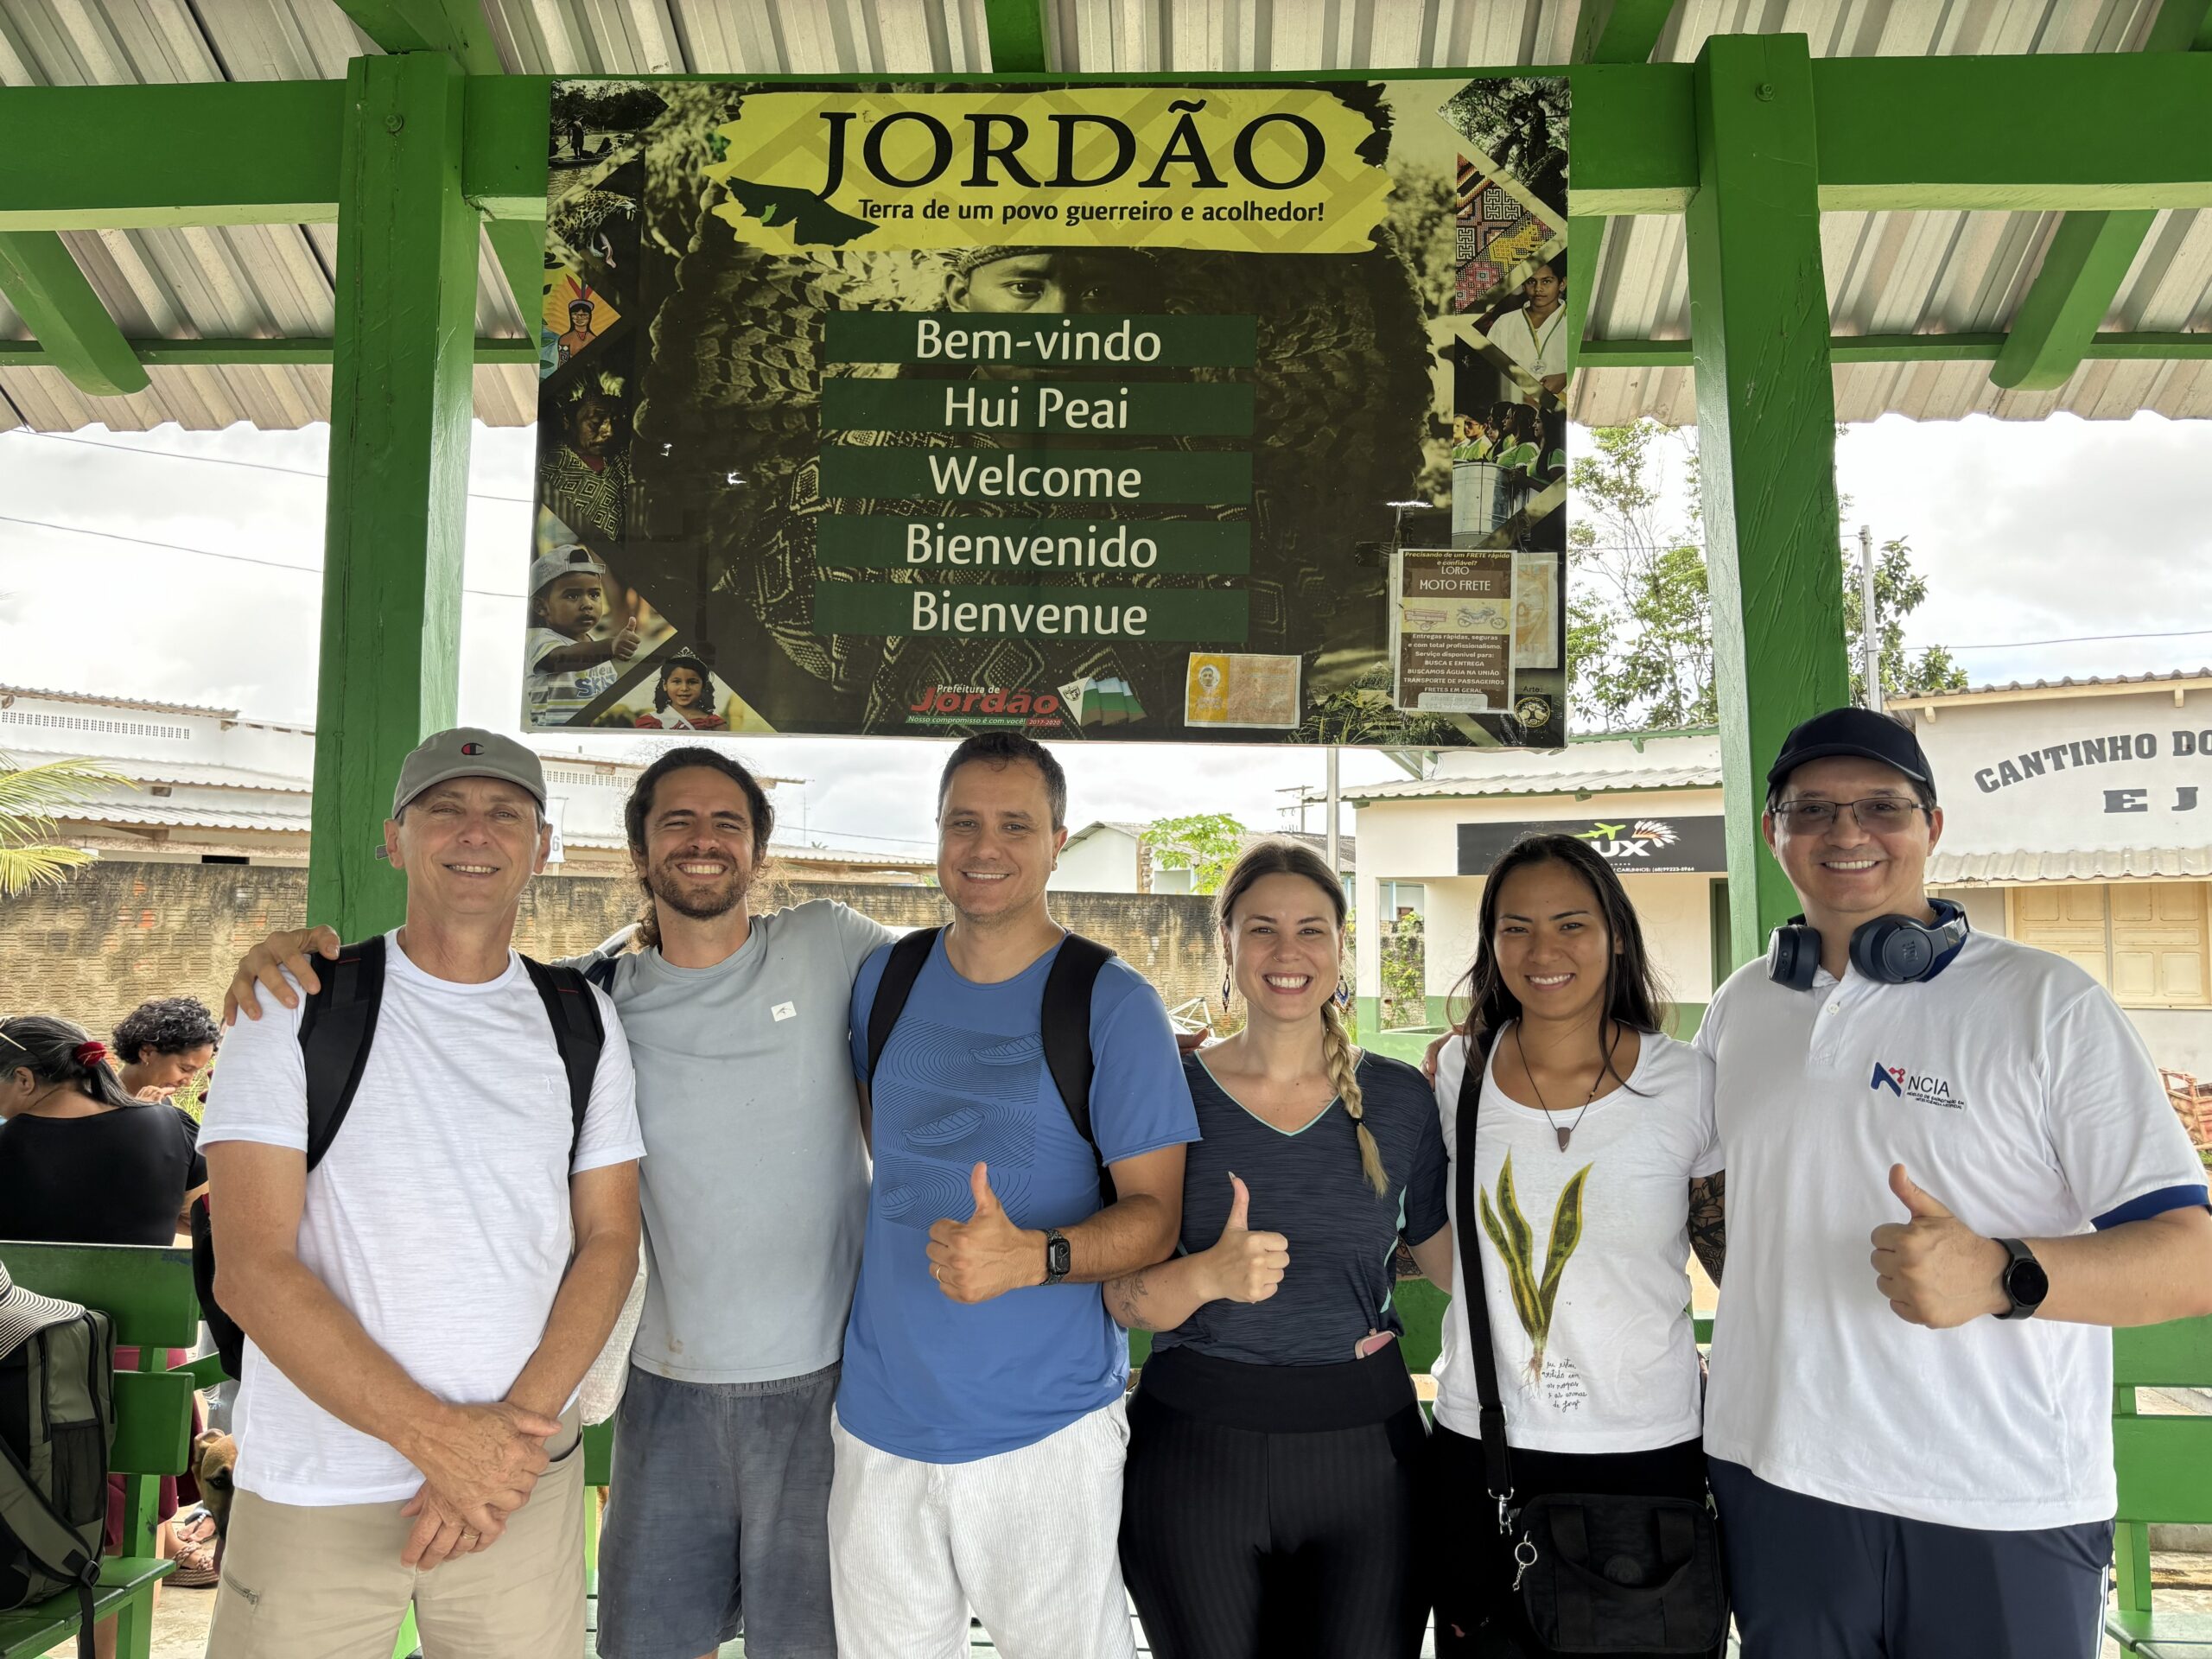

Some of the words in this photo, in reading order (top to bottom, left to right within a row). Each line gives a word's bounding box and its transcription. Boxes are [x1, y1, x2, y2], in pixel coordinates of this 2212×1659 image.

[813, 99, 1326, 201] JORDÃO
[858, 200, 913, 219] Terra
[922, 199, 949, 219] de
[957, 203, 994, 220] um
[1002, 204, 1058, 225] povo
[1066, 200, 1173, 226] guerreiro
[1181, 205, 1194, 222] e
[1202, 200, 1325, 223] acolhedor!
[916, 319, 1161, 361] Bem-vindo
[944, 386, 1020, 428] Hui
[1038, 387, 1128, 429] Peai
[928, 454, 1141, 499] Welcome
[906, 523, 1158, 568] Bienvenido
[1419, 579, 1458, 590] MOTO
[1459, 580, 1491, 591] FRETE
[1441, 566, 1470, 575] LORO
[912, 590, 1147, 636] Bienvenue
[911, 687, 1060, 715] Jordão
[936, 683, 985, 694] Prefeitura
[988, 684, 1001, 694] de
[931, 716, 982, 725] compromisso
[1974, 733, 2158, 793] CANTINHO
[1907, 1076, 1950, 1097] NCIA
